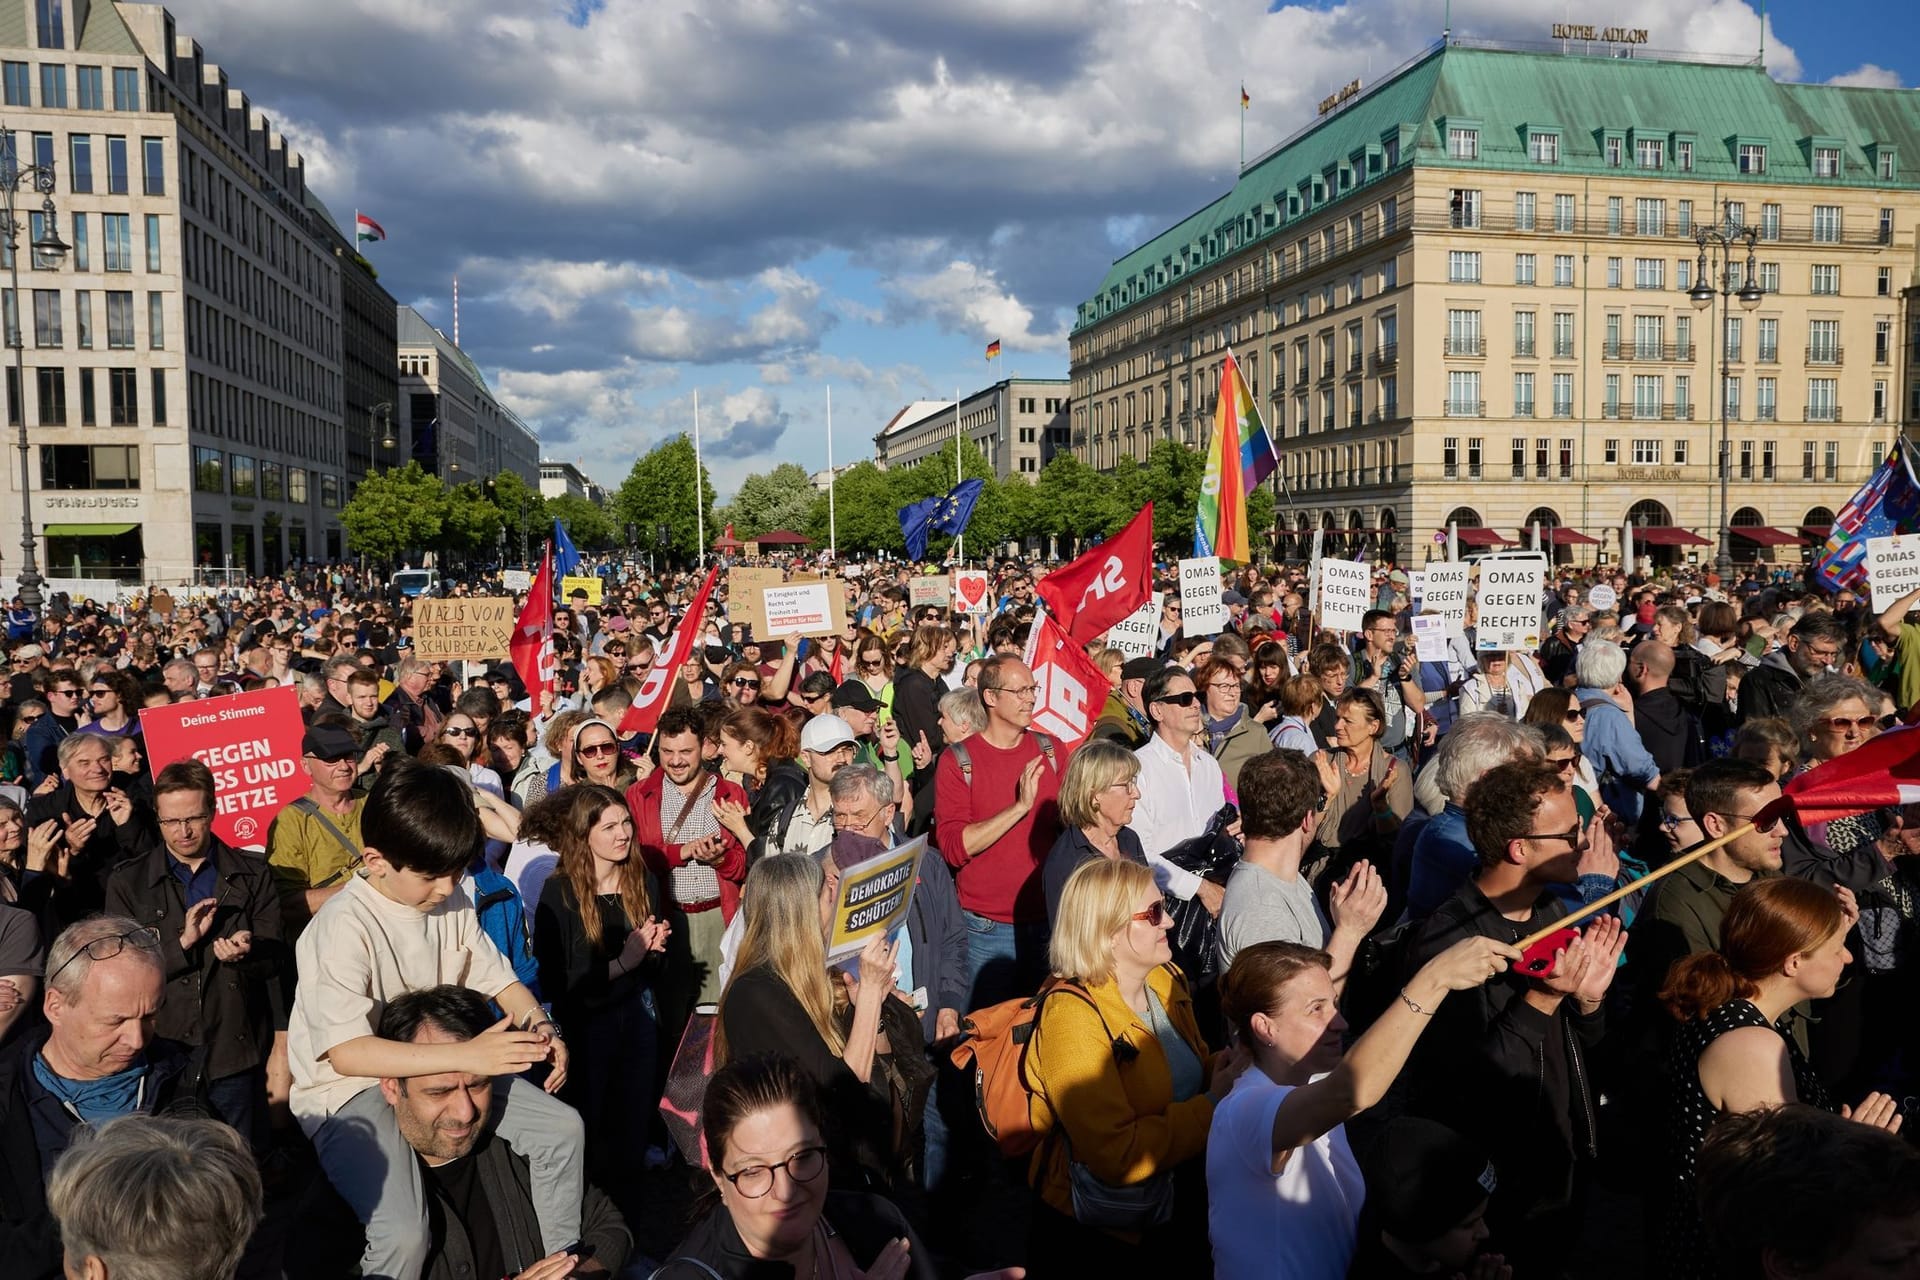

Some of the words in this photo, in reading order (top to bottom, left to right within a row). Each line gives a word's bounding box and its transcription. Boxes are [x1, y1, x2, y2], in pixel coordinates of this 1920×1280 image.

[1552, 24, 1598, 41] HOTEL
[1601, 27, 1649, 43] ADLON
[1617, 468, 1646, 480] HOTEL
[1648, 468, 1681, 480] ADLON
[46, 496, 139, 508] STARBUCKS
[1876, 551, 1916, 563] OMAS
[1185, 566, 1215, 579] OMAS
[1329, 567, 1365, 580] OMAS
[1430, 572, 1463, 583] OMAS
[1488, 572, 1535, 584] OMAS
[1875, 566, 1919, 579] GEGEN
[1185, 585, 1218, 599] GEGEN
[1326, 584, 1366, 598] GEGEN
[1876, 582, 1920, 595] RECHT
[1427, 590, 1463, 602] GEGEN
[1484, 594, 1536, 606] GEGEN
[418, 604, 466, 622] NAZIS
[471, 605, 505, 621] VON
[1184, 603, 1221, 618] RECHTS
[1324, 601, 1369, 615] RECHTS
[1443, 609, 1463, 620] HTS
[1115, 621, 1155, 635] GEGEN
[1481, 616, 1538, 628] RECHTS
[180, 713, 216, 728] Deine
[219, 705, 265, 721] Stimme
[191, 738, 272, 768] GEGEN
[215, 769, 239, 791] SS
[244, 759, 296, 785] UND
[849, 863, 911, 904] DEMOKRATIE
